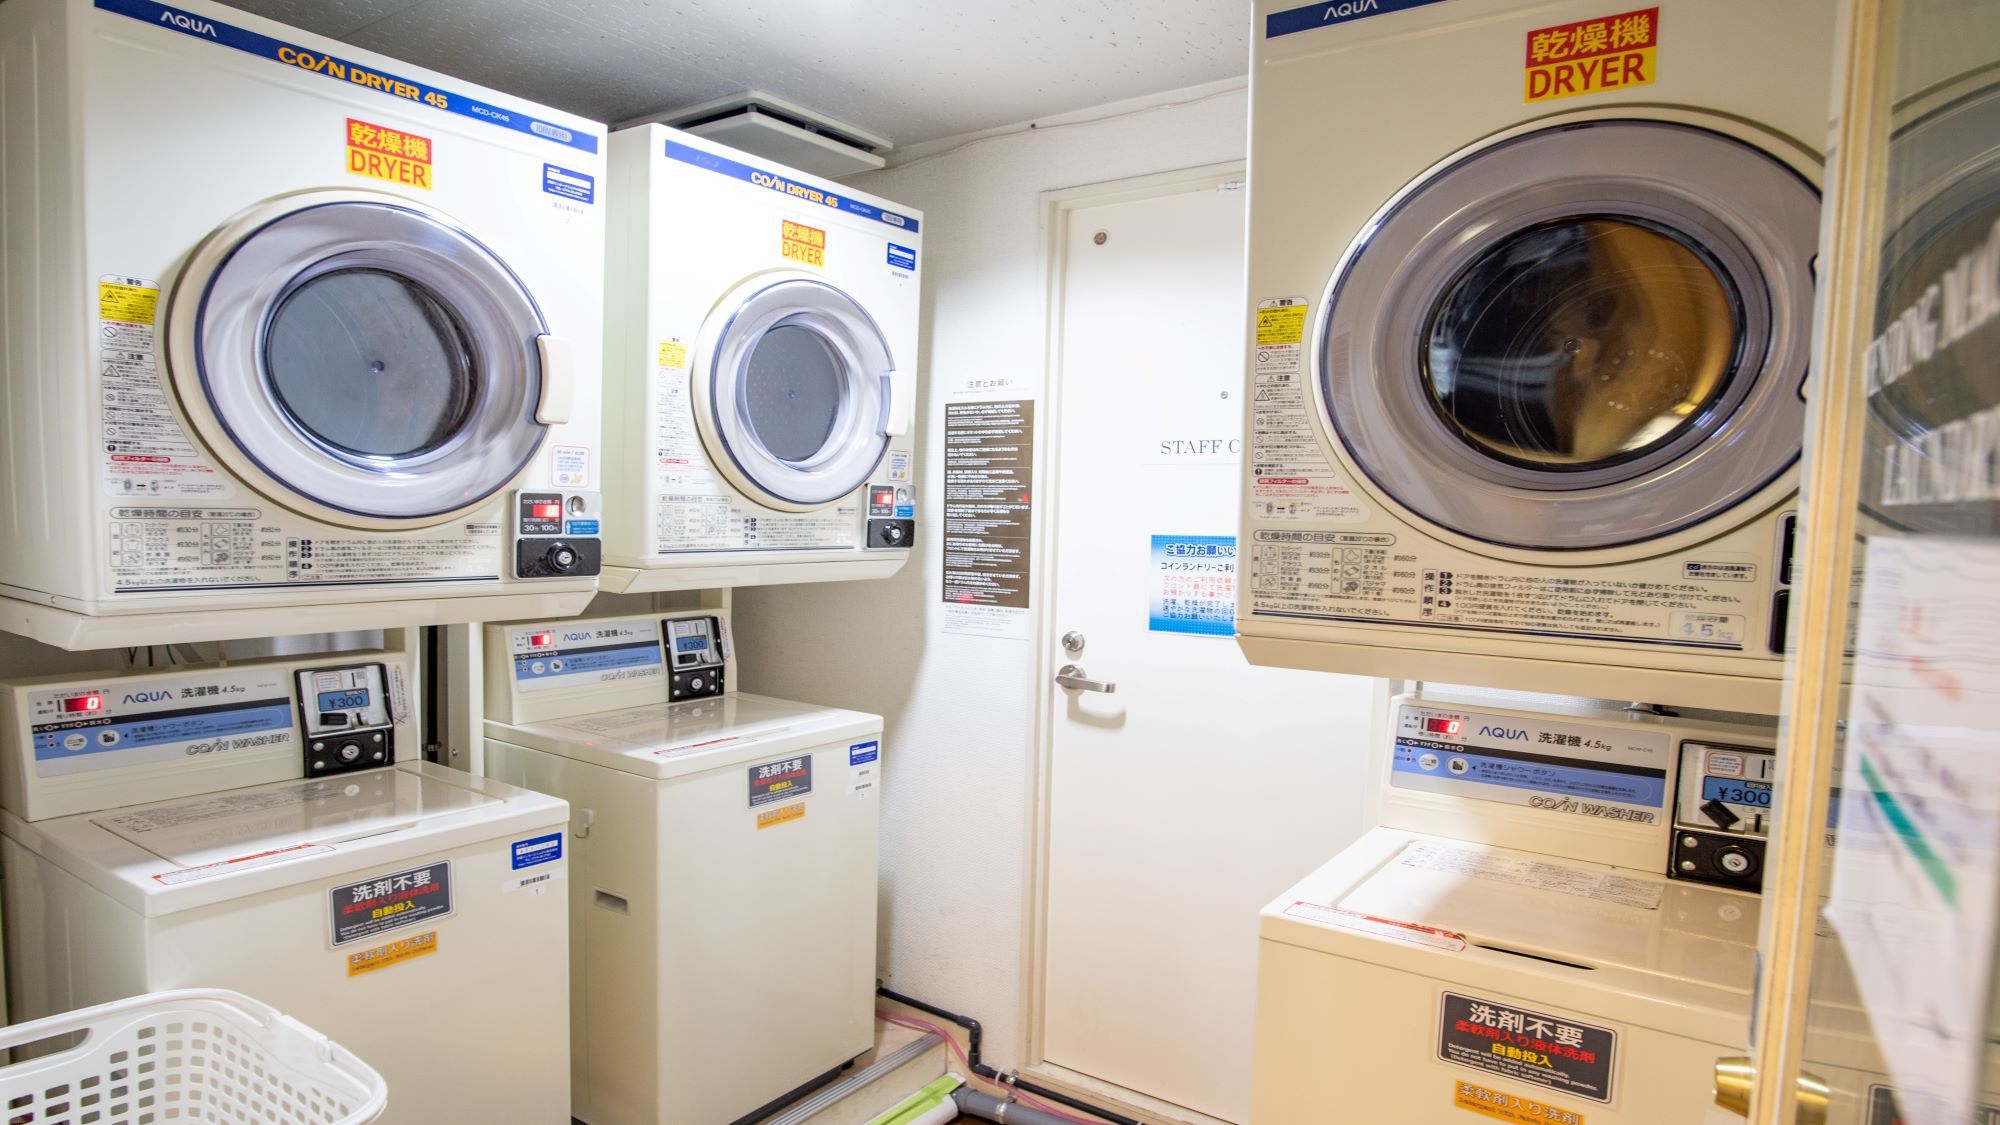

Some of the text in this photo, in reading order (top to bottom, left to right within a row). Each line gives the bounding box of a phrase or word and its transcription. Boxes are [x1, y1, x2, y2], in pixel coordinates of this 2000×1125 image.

[160, 11, 217, 37] AQUA
[1531, 15, 1650, 63] 乾燥機
[1528, 52, 1646, 100] DRYER
[350, 70, 421, 102] DRYER
[425, 92, 449, 110] 45
[350, 122, 429, 162] 乾燥機
[351, 150, 427, 187] DRYER
[786, 182, 824, 205] DRYER
[825, 195, 838, 208] 45
[782, 221, 823, 246] 乾燥機
[782, 241, 822, 266] DRYER
[1160, 439, 1223, 455] STAFF
[1259, 531, 1336, 543] 乾燥時間の目安
[1253, 601, 1390, 616] 4.5kg以上の洗濯物を入れないでください。
[563, 632, 592, 642] AQUA
[596, 629, 618, 639] 洗濯機
[87, 697, 99, 710] 0
[123, 690, 173, 704] AQUA
[180, 685, 220, 699] 洗濯機
[328, 695, 364, 709] ¥300
[1447, 721, 1460, 733] 0
[1478, 726, 1529, 741] AQUA
[1537, 731, 1582, 748] 洗濯機
[1583, 740, 1612, 751] 4.5kg
[232, 732, 289, 750] WASHER
[758, 758, 802, 779] 洗剤不要
[1718, 786, 1771, 805] ¥300
[1581, 803, 1655, 824] WASHER
[343, 882, 442, 915] 柔軟剤入り液体洗剤
[352, 869, 431, 903] 洗剤不要
[372, 900, 416, 919] 自動投入
[1468, 1003, 1584, 1048] 洗剤不要
[1448, 1042, 1480, 1056] Detergent
[1502, 1056, 1523, 1066] added
[1455, 1019, 1596, 1065] 柔軟剤入り液体洗剤
[1491, 1043, 1553, 1068] 自動投入
[1541, 1072, 1570, 1085] washing
[1459, 1083, 1579, 1125] 柔軟剤入り洗剤
